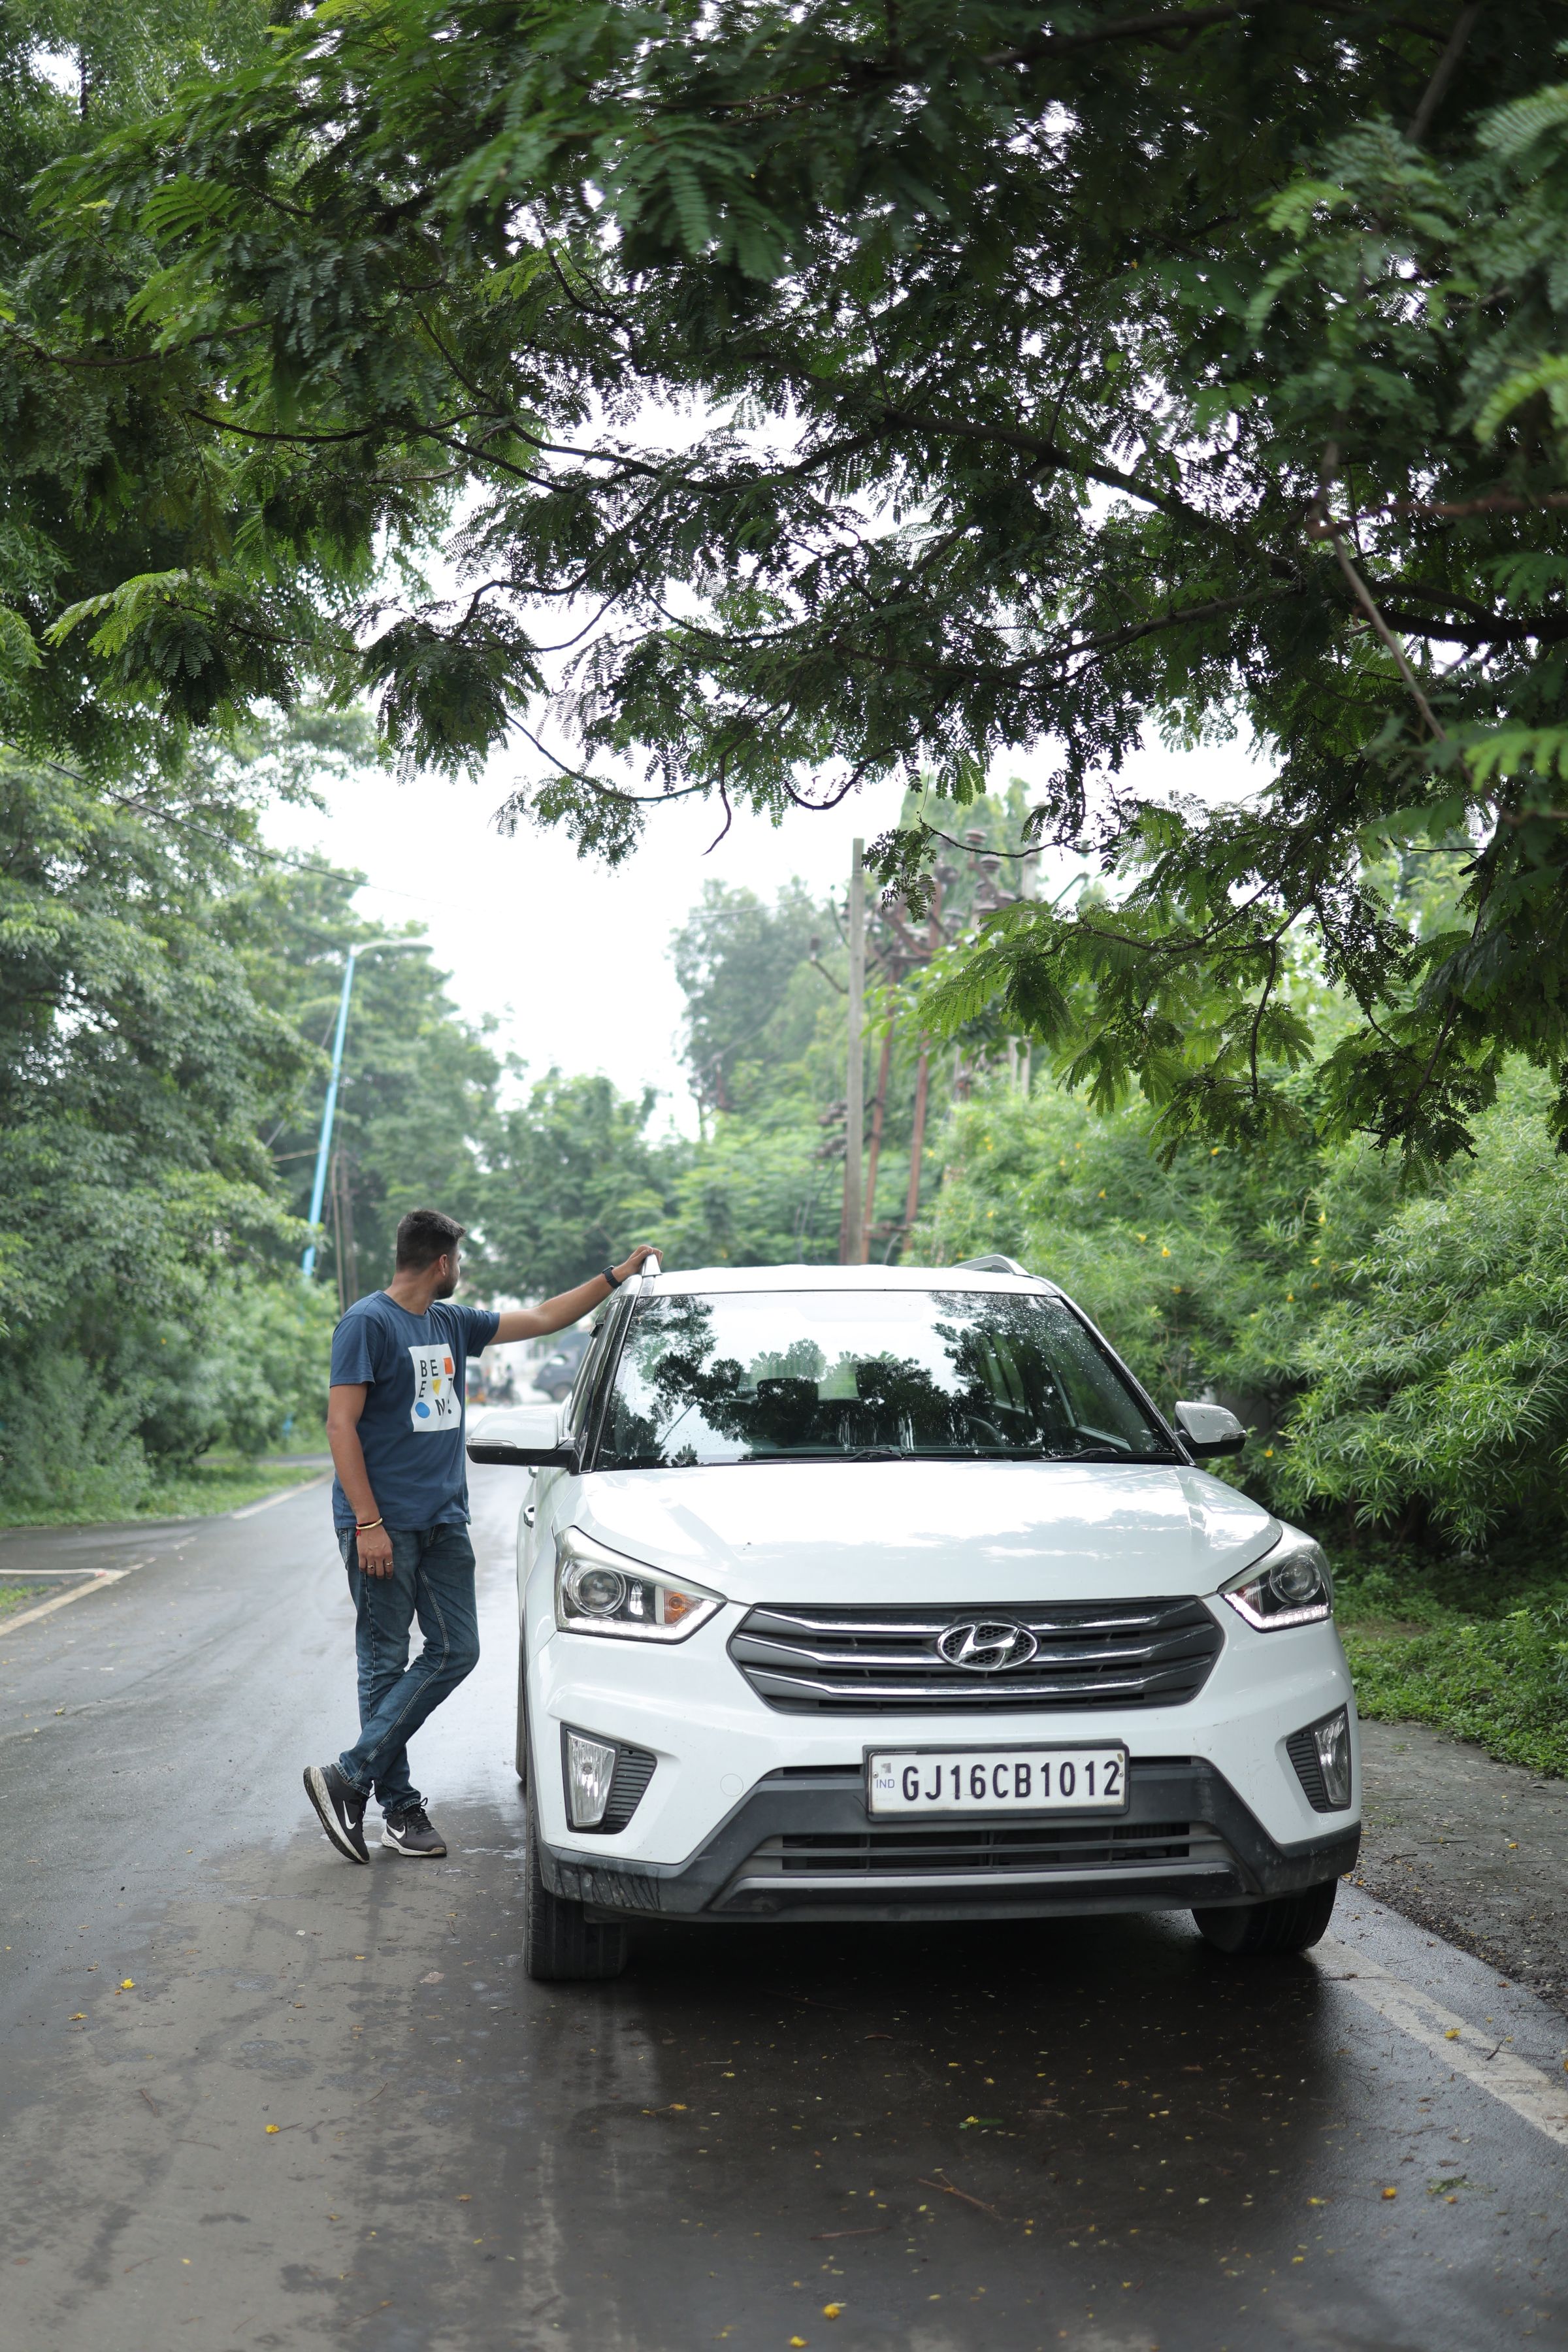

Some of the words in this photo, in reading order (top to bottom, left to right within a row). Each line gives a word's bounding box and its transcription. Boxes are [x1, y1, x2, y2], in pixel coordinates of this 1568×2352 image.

[419, 1359, 438, 1377] BE
[418, 1380, 427, 1397] E
[876, 1778, 894, 1788] IND
[902, 1760, 1120, 1801] GJ16CB1012
